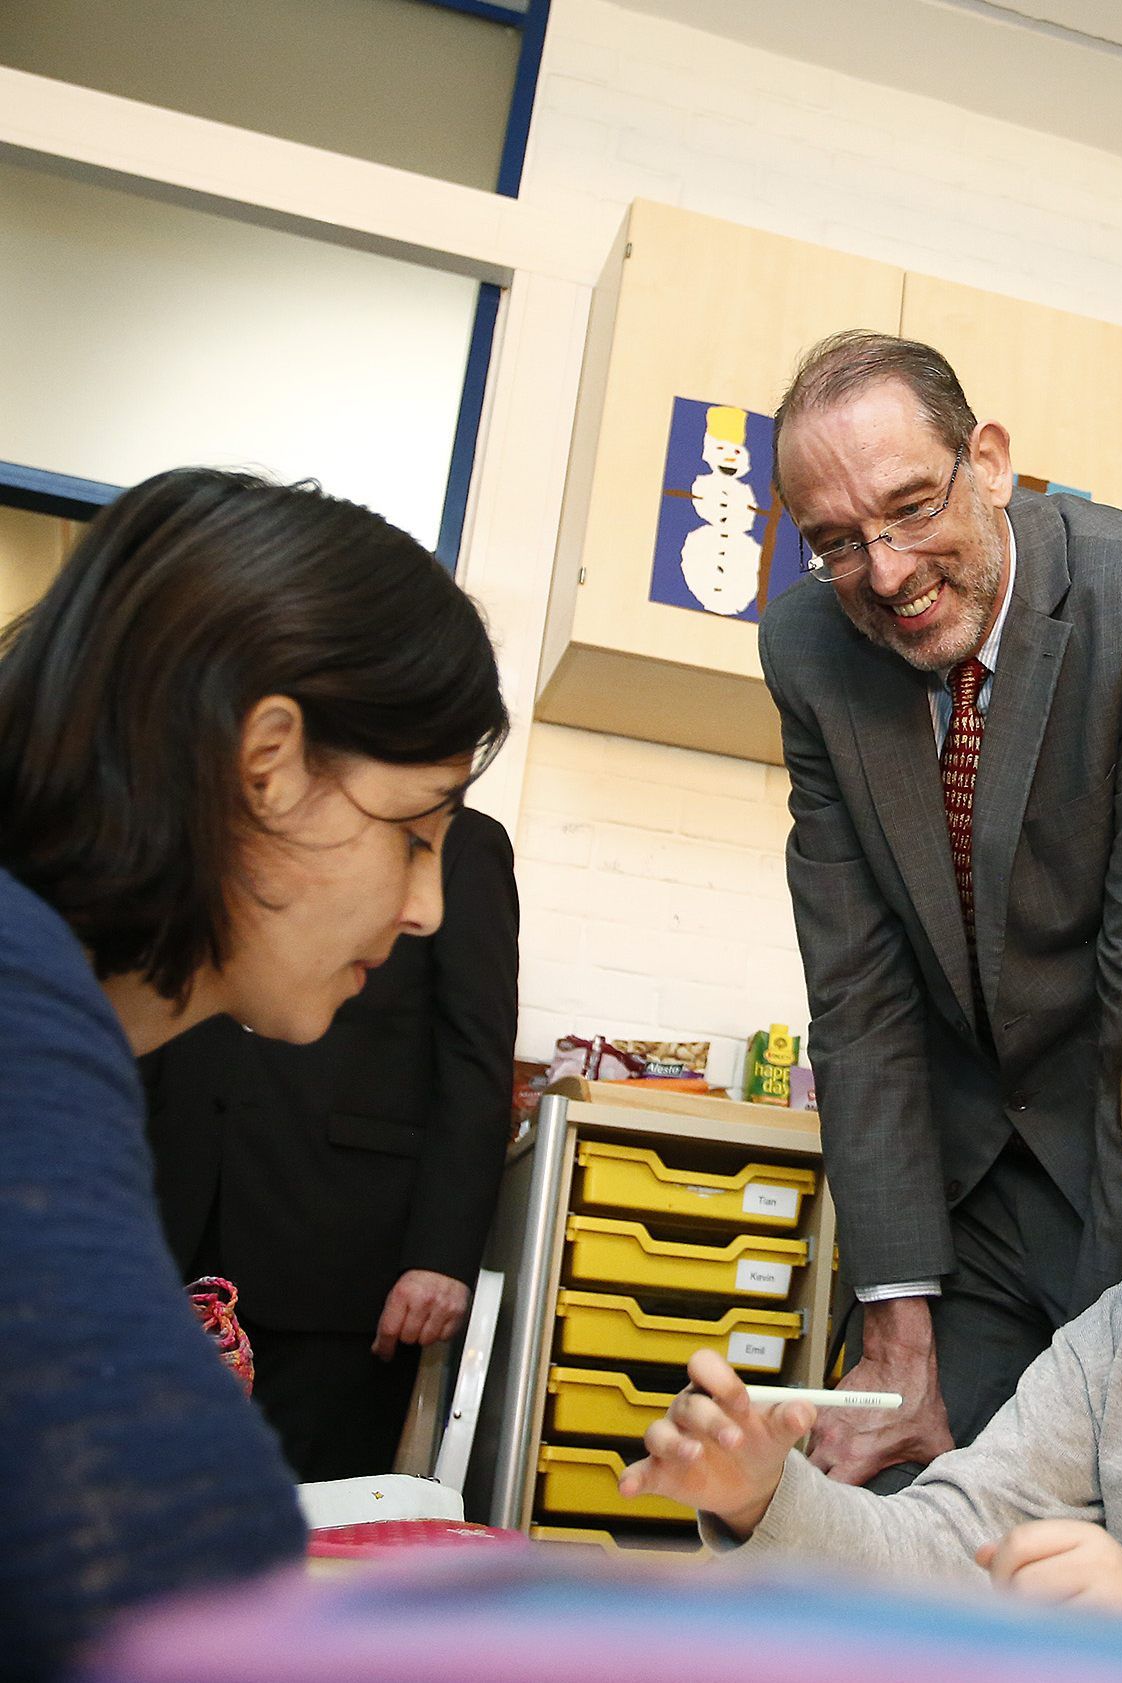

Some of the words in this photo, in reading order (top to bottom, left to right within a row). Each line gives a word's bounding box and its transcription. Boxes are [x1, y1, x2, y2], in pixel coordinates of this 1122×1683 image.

[647, 1062, 680, 1075] Alesto
[754, 1061, 790, 1083] happ
[763, 1077, 790, 1099] day
[750, 1272, 775, 1282] Kevin
[745, 1344, 766, 1355] Emil
